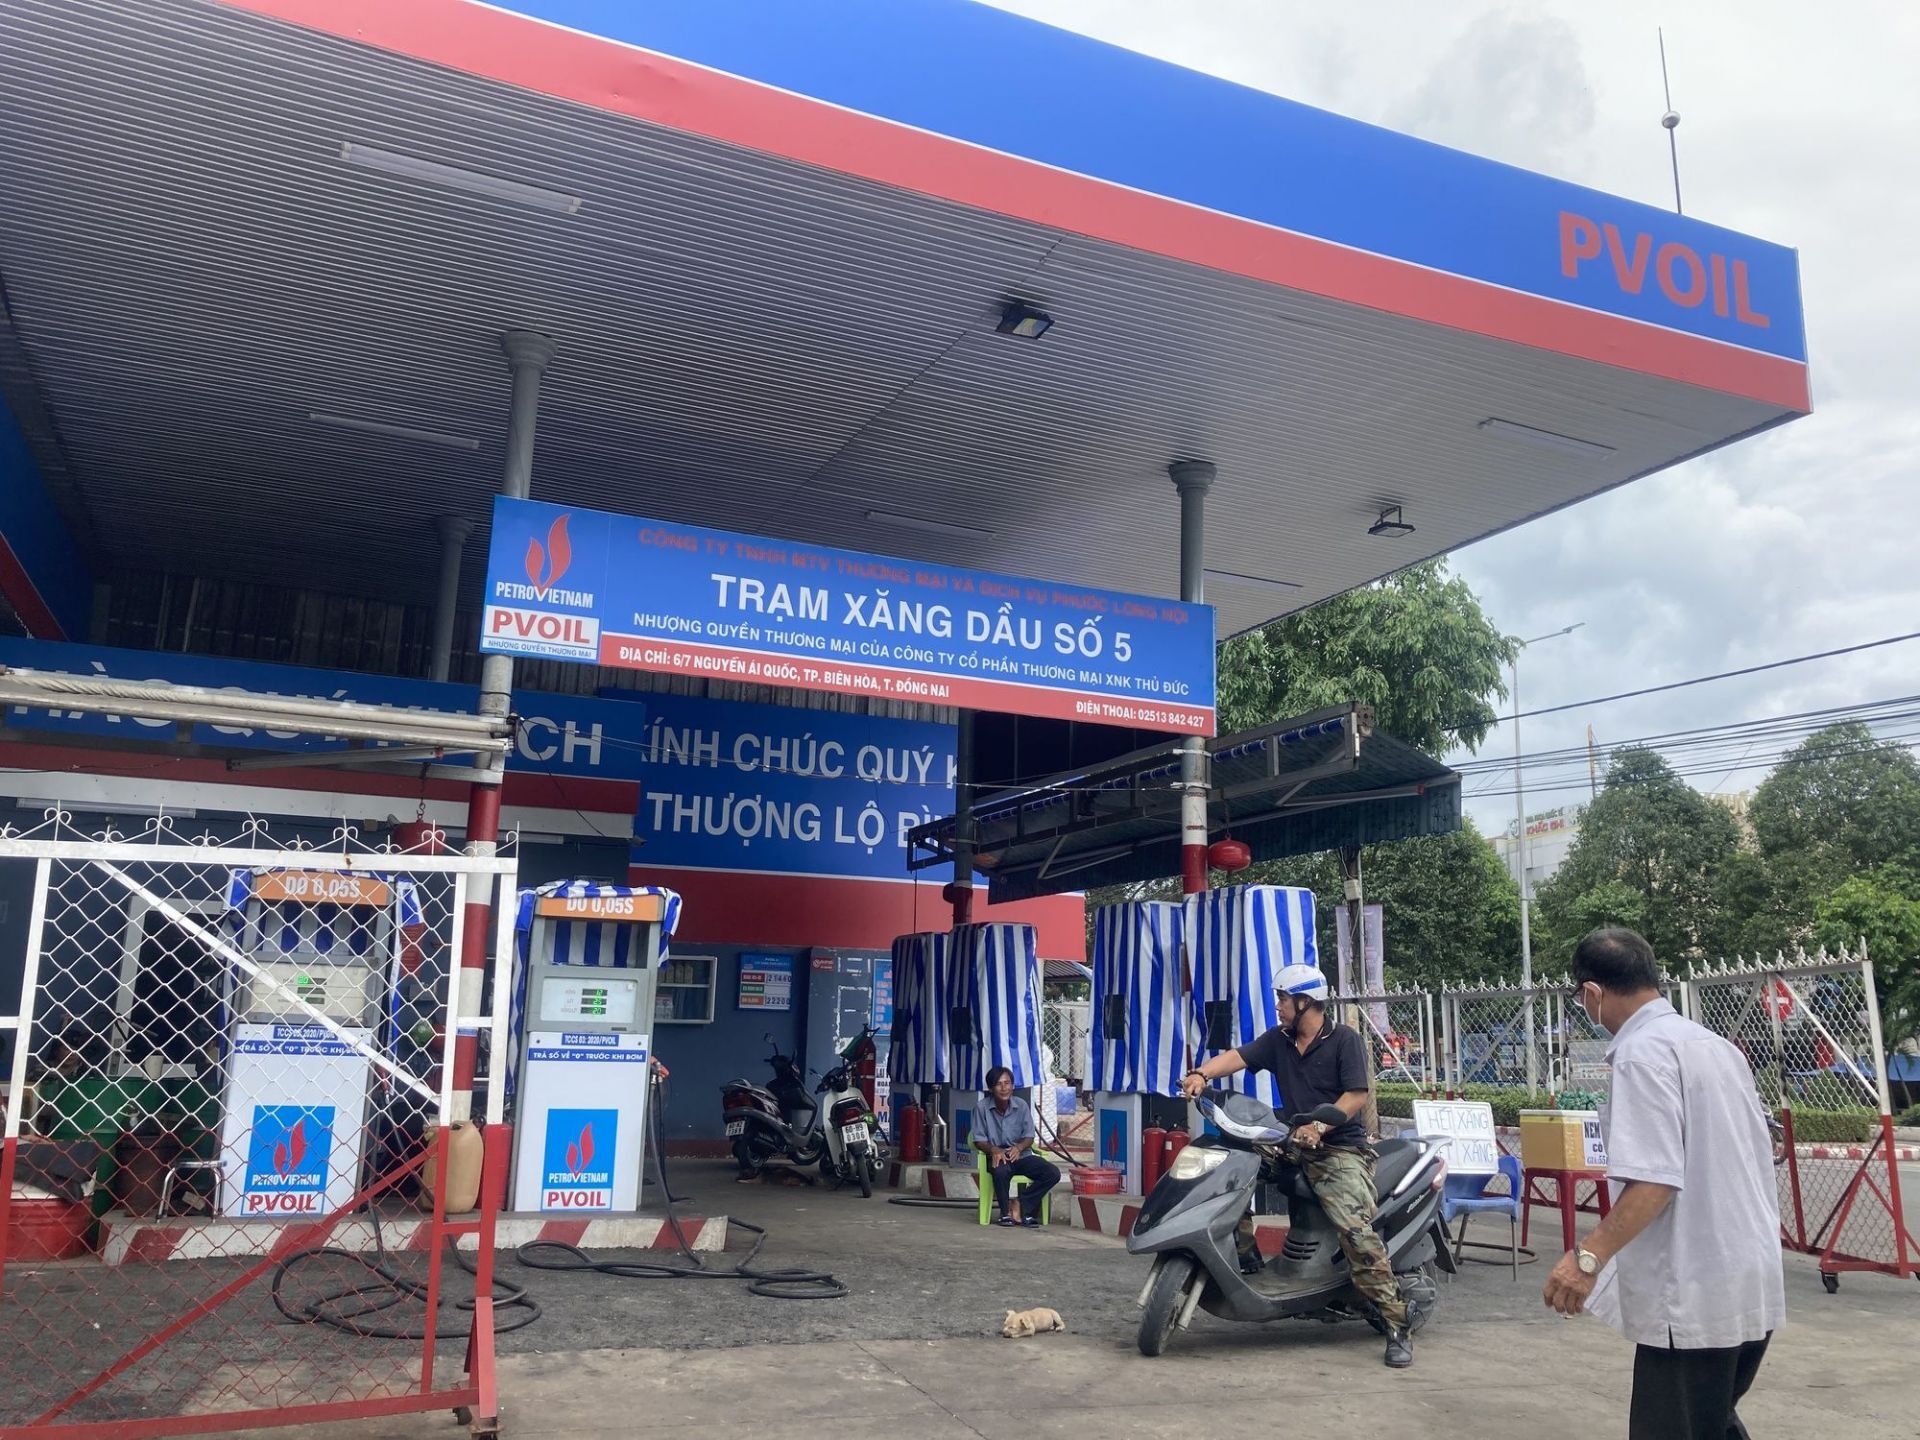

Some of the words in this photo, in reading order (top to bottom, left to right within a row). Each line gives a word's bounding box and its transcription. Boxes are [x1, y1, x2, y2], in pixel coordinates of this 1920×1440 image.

[1559, 210, 1771, 329] PVOIL
[639, 528, 698, 552] CÔNG
[706, 539, 729, 557] TY
[496, 581, 594, 609] PETROVIETNAM
[492, 609, 590, 644] PVOIL
[711, 573, 829, 622] TRẠM
[843, 588, 952, 639] XĂNG
[967, 602, 1042, 650] DẦU
[1054, 615, 1104, 658] SỐ
[1114, 632, 1133, 662] 5
[634, 612, 702, 634] NHƯỢNG
[706, 621, 760, 640] QUYỀN
[765, 629, 826, 649] THƯƠNG
[830, 638, 856, 657] MẠI
[860, 638, 890, 658] CỦA
[894, 645, 934, 663] CÔNG
[938, 652, 956, 665] TY
[958, 650, 978, 669] CỔ
[982, 655, 1019, 675] PHẦN
[1022, 662, 1076, 681] THƯƠNG
[1080, 670, 1102, 686] MẠI
[1106, 674, 1132, 689] XNK
[1135, 675, 1160, 692] THỦ
[1163, 680, 1190, 696] ĐỨC
[620, 646, 641, 664] ĐỊA
[674, 653, 691, 668] 6/7
[694, 656, 746, 674] NGUYỄN
[748, 659, 761, 676] ÁI
[764, 663, 801, 682] QUỐC,
[803, 668, 821, 683] TP.
[824, 670, 852, 687] BIÊN
[854, 673, 881, 692] HÒA,
[884, 678, 894, 691] T.
[930, 684, 950, 698] NAI
[1076, 700, 1100, 716] ĐIỆN
[1102, 704, 1137, 721] THOẠI:
[1138, 709, 1167, 724] 02513
[1168, 712, 1185, 726] 842
[1187, 715, 1205, 728] 427
[641, 716, 721, 767] ÍNH
[733, 732, 845, 779] CHÚC
[856, 745, 935, 786] QUÝ
[647, 791, 821, 847] THƯỢNG
[835, 800, 886, 854] LỘ
[1457, 1109, 1489, 1130] XĂNG
[548, 1172, 609, 1184] PETROVIETNAM
[249, 1194, 317, 1212] PVOIL
[547, 1191, 606, 1208] PVOIL
